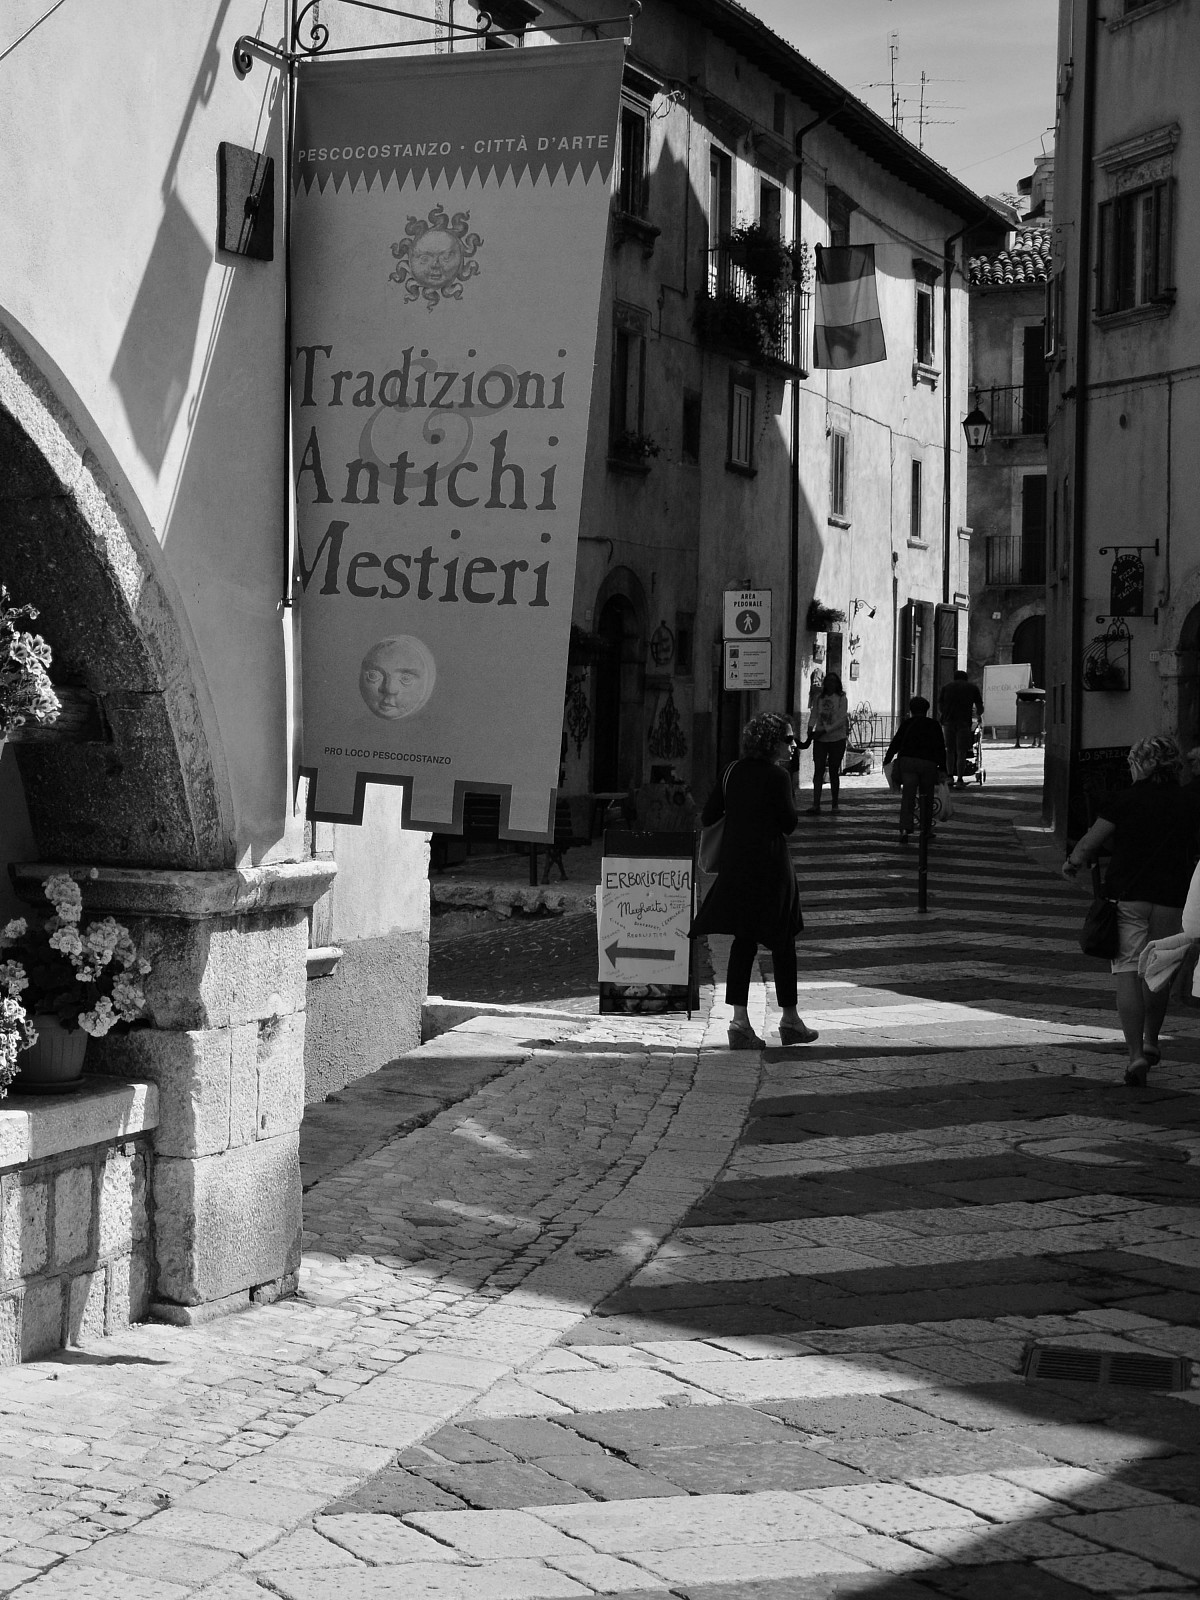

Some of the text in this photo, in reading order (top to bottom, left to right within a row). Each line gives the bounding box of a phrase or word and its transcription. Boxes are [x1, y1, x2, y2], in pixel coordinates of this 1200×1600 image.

[298, 134, 609, 162] PESCOCOSTANZO CITTÀ D'ARTE
[296, 345, 567, 409] Tradizioni
[296, 426, 560, 510] Antichi
[297, 520, 552, 607] Mestieri
[324, 747, 452, 765] PRO LOCO PESCOCOSTANZO
[1093, 749, 1129, 761] SPIZZIC
